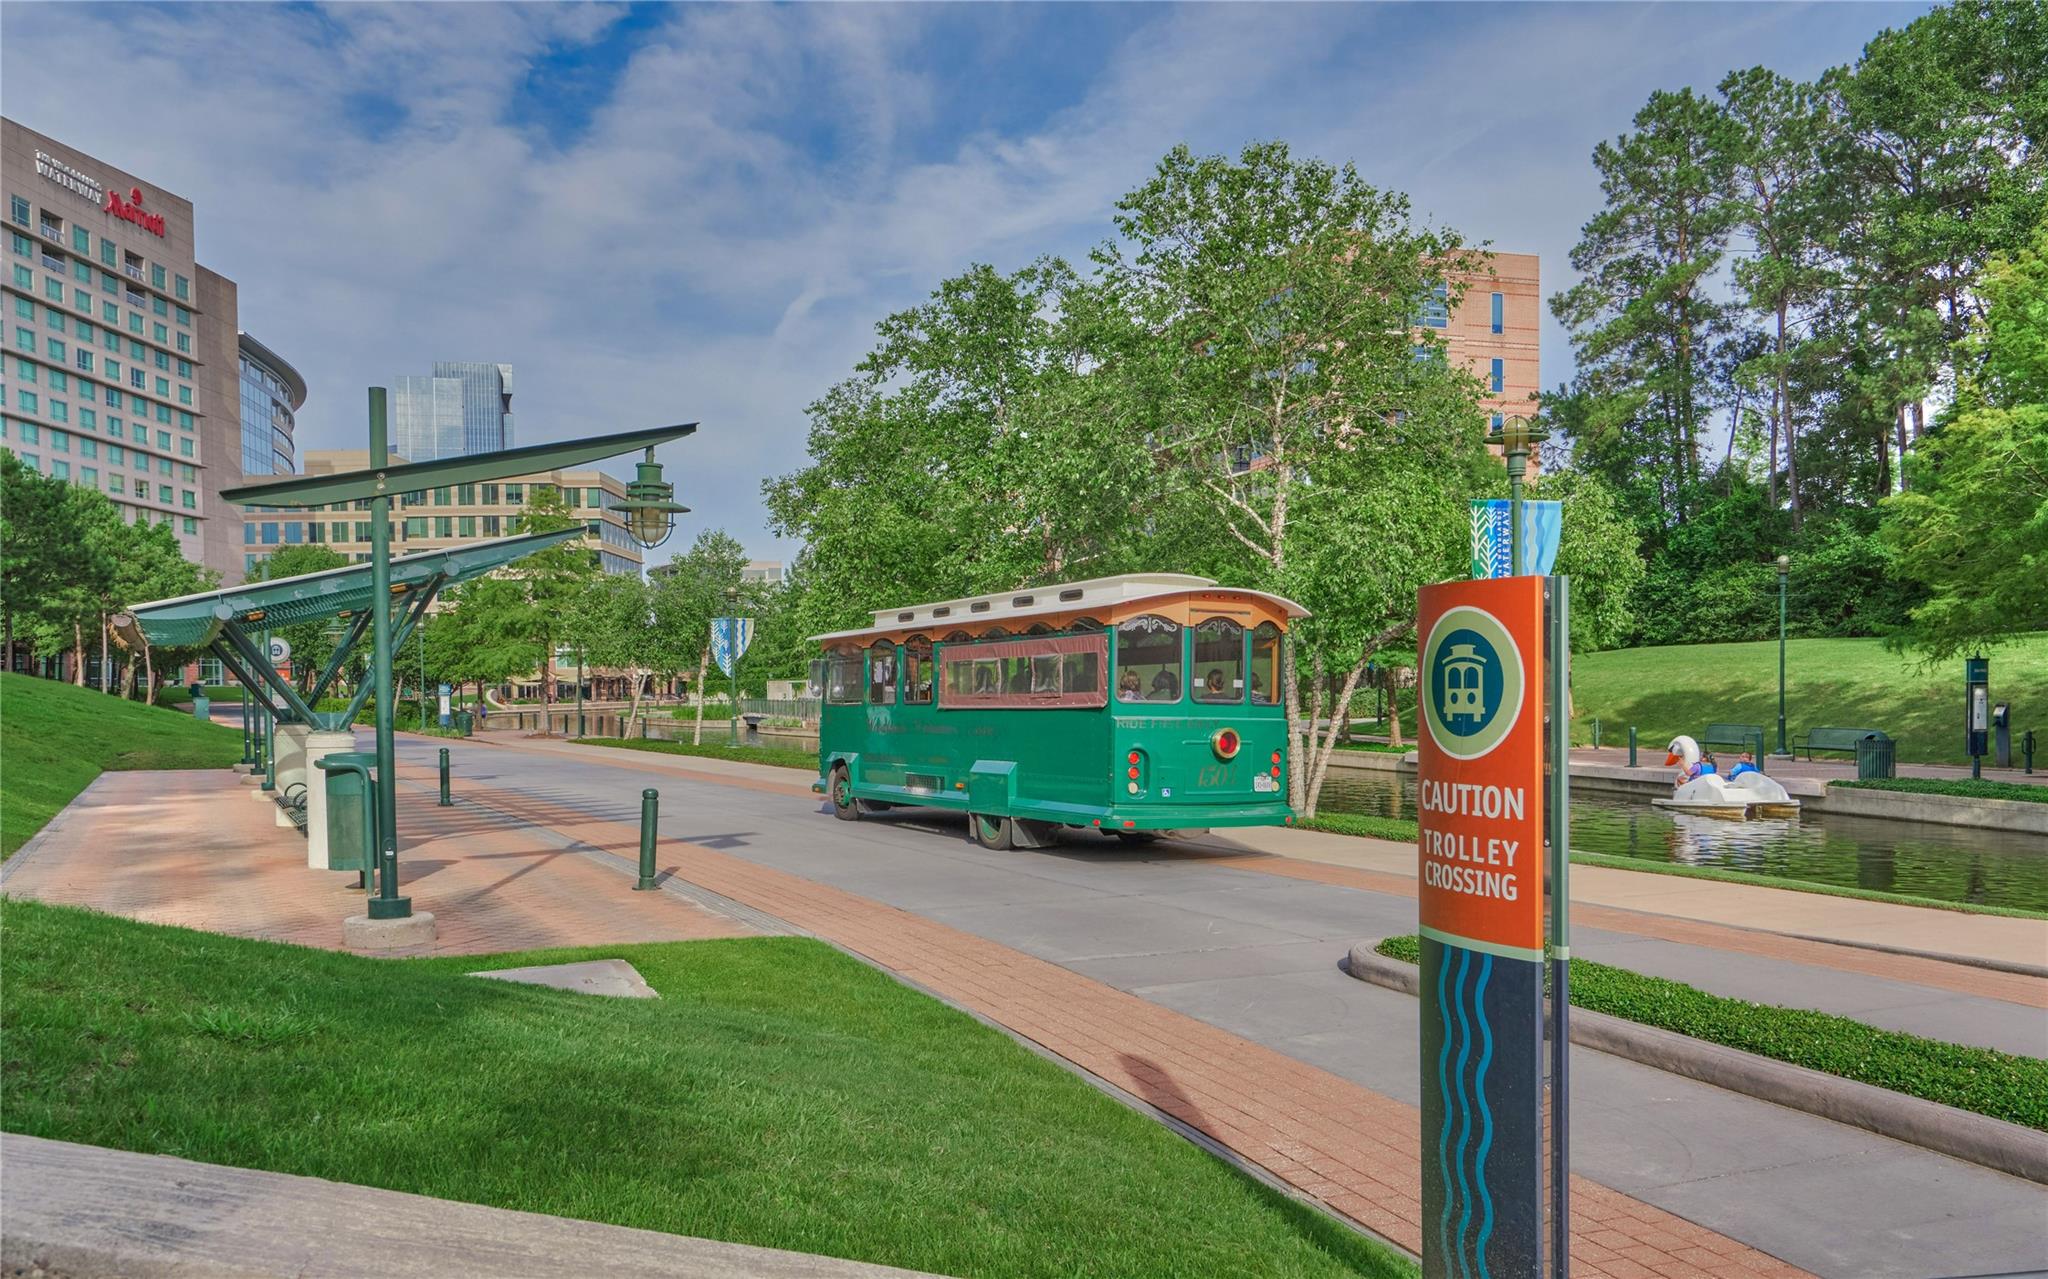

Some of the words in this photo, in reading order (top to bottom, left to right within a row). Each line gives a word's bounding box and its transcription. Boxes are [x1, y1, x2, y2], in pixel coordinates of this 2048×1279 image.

[35, 159, 102, 204] WATERWAY
[1502, 511, 1510, 578] WATERWAY
[1116, 718, 1147, 729] RIDE
[1421, 778, 1525, 821] CAUTION
[1423, 828, 1520, 867] TROLLEY
[1424, 860, 1518, 901] CROSSING
